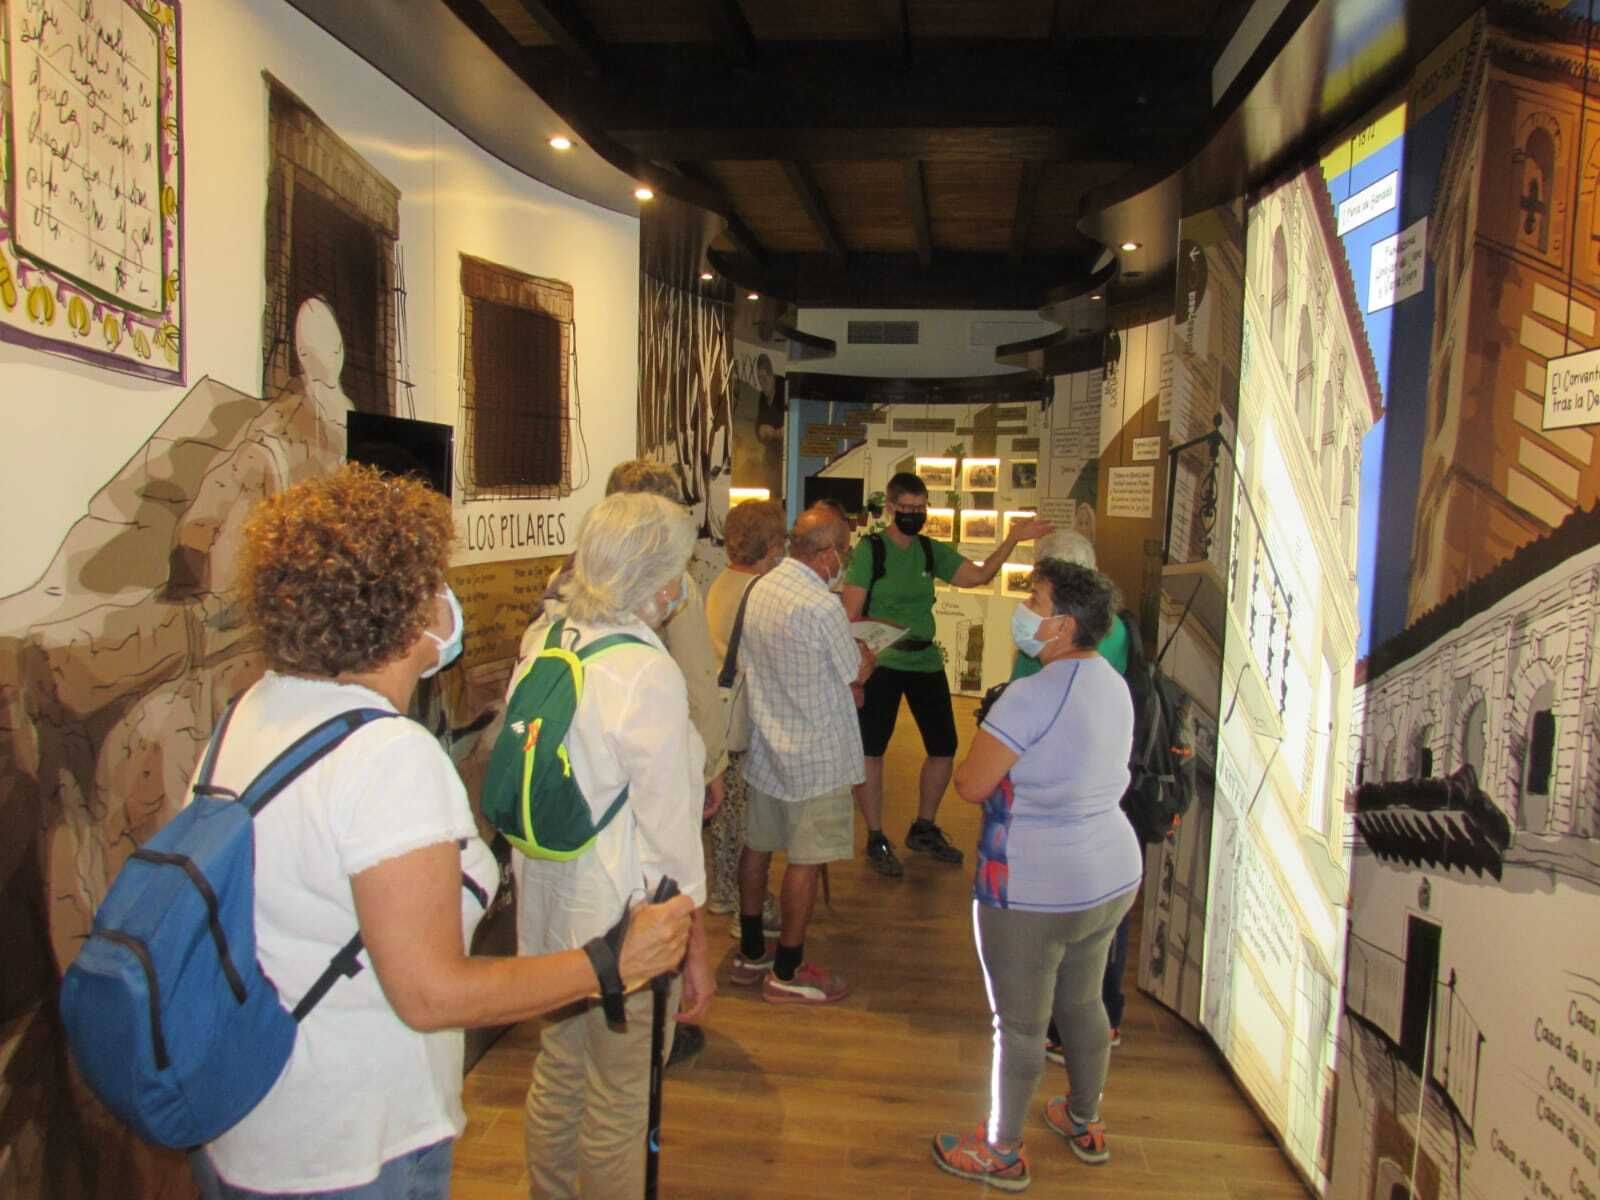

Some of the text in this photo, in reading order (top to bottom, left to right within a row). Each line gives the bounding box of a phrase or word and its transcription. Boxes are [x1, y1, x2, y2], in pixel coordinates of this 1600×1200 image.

[1553, 395, 1571, 412] tras
[1575, 393, 1584, 408] la
[467, 511, 566, 551] LOS PILARES
[1535, 1016, 1562, 1051] Casa
[1569, 999, 1597, 1035] Casa
[1547, 1064, 1575, 1103] Casa
[1536, 1095, 1564, 1133] Casa
[1491, 1128, 1516, 1166] Casa
